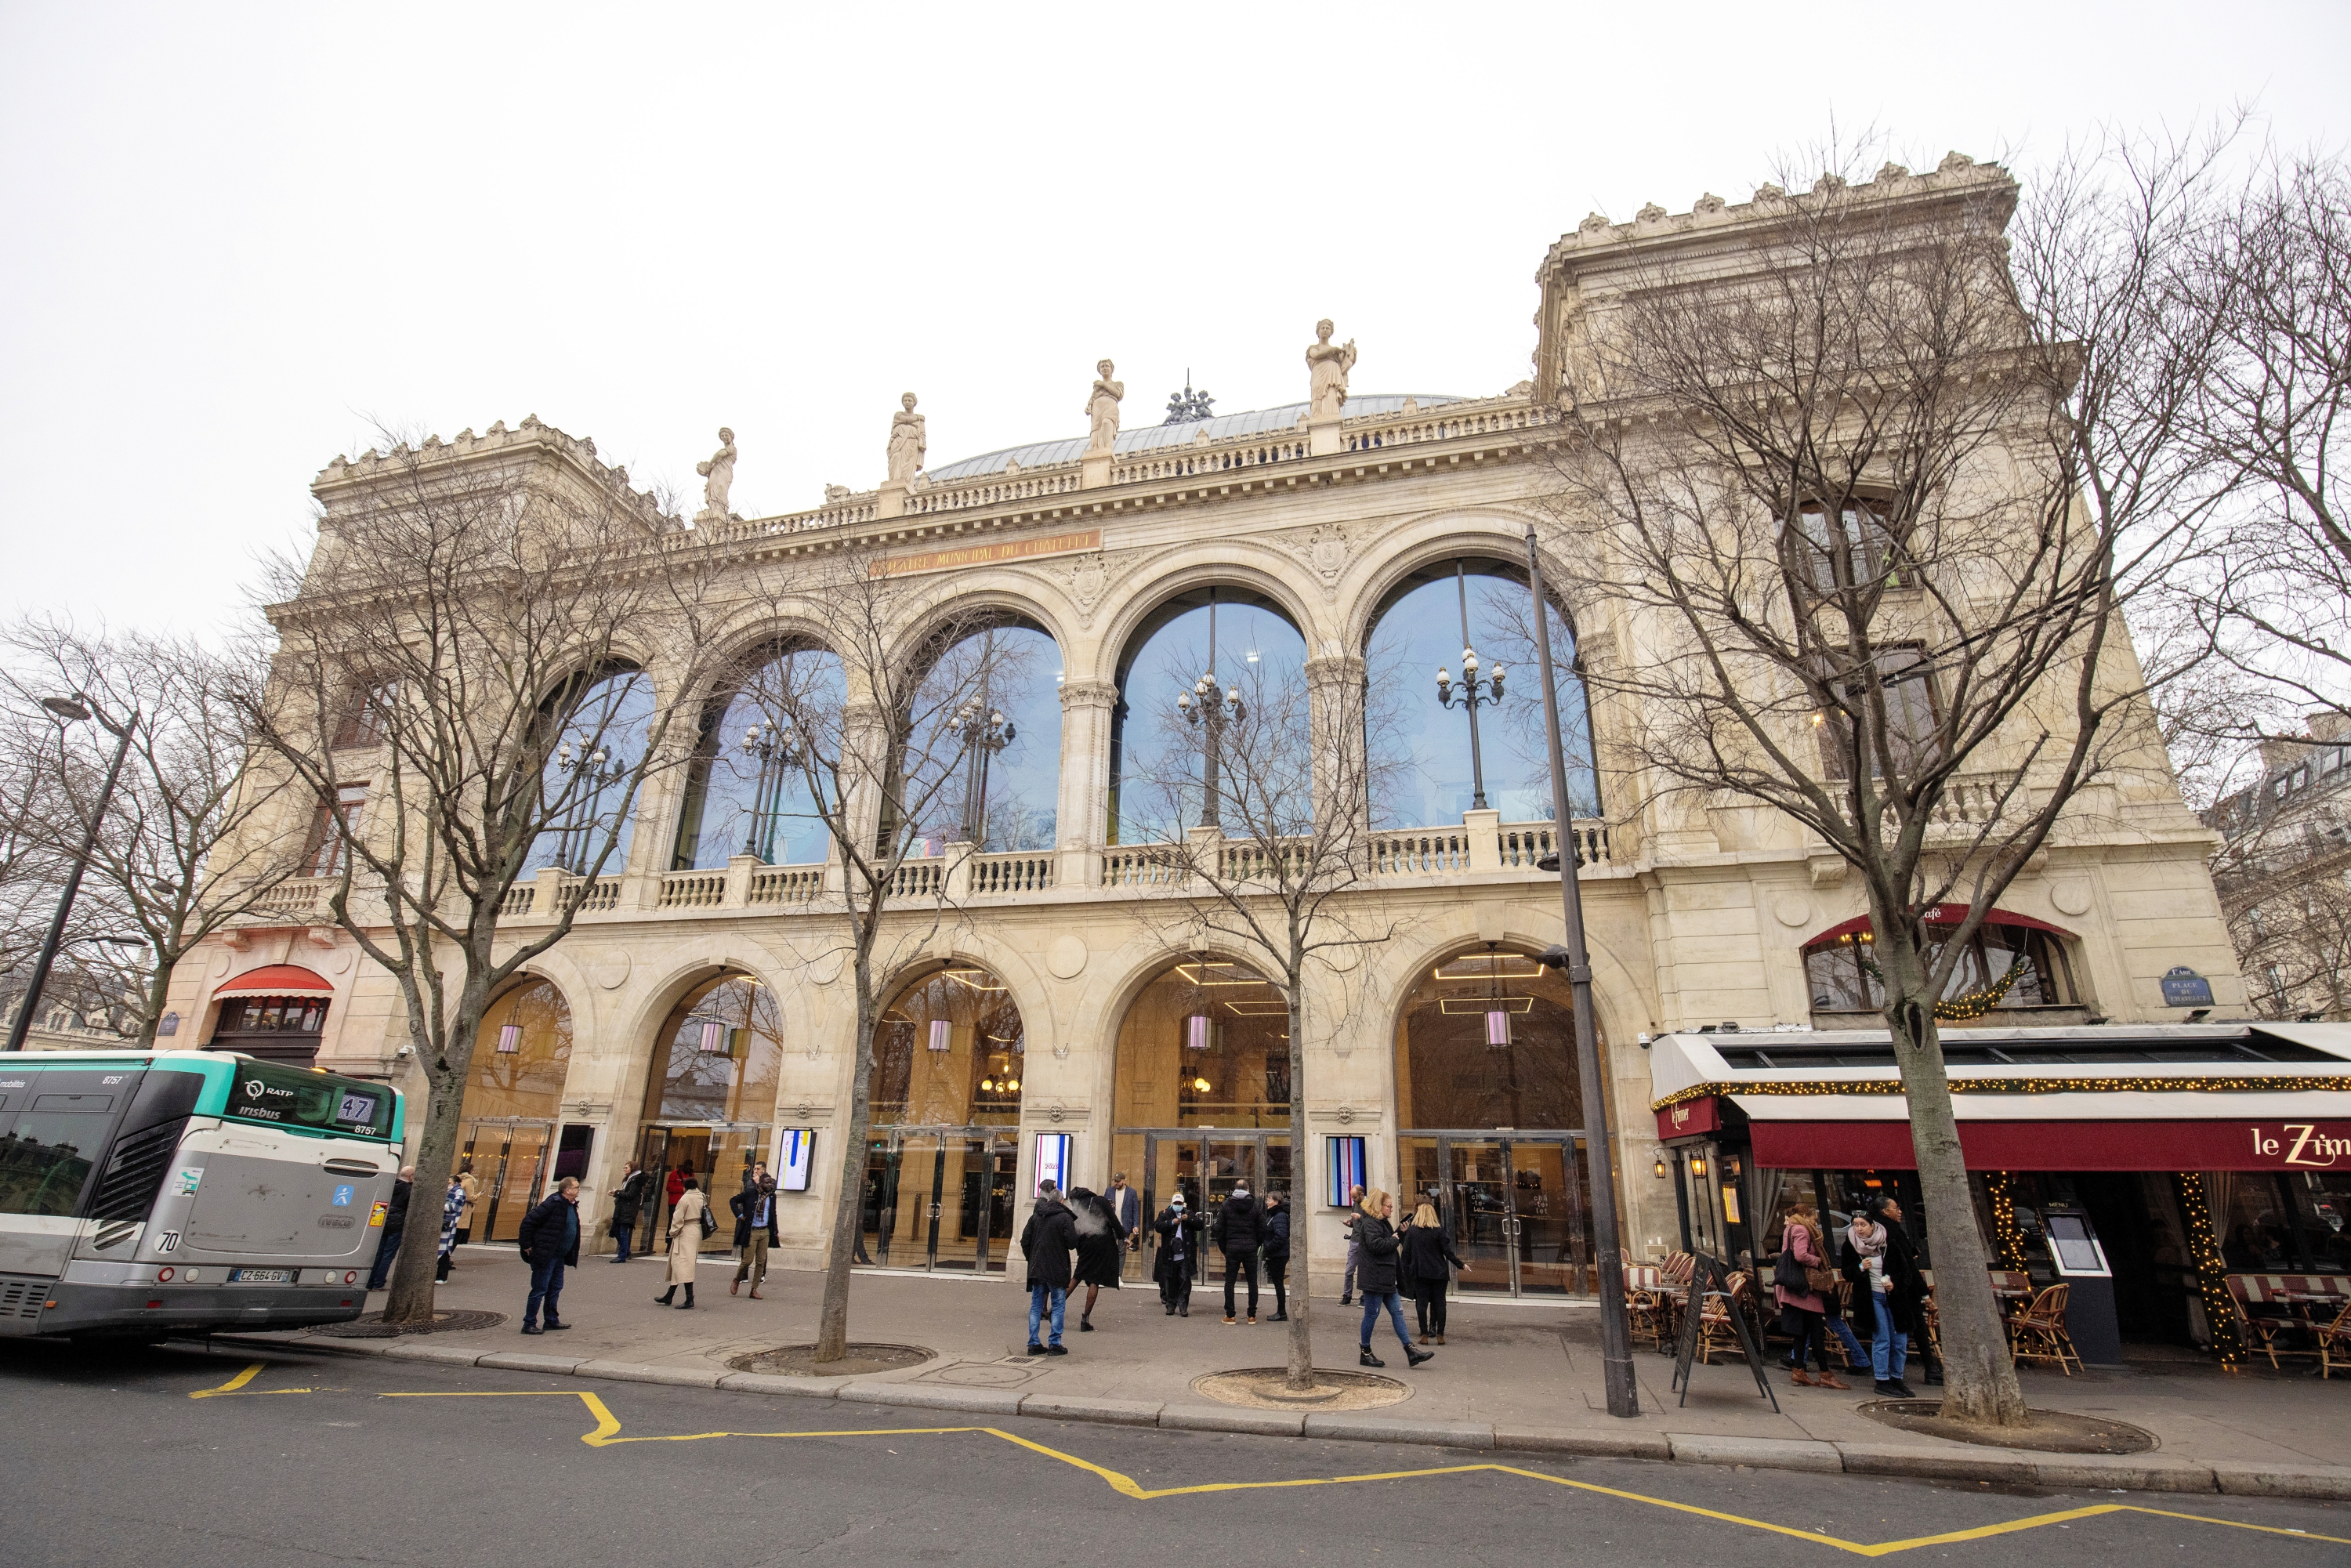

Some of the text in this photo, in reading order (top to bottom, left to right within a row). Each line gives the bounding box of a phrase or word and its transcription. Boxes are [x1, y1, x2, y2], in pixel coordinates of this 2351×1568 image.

[1002, 544, 1018, 557] DU
[1923, 907, 1941, 920] afé
[0, 1080, 26, 1088] mobilités
[102, 1075, 123, 1085] 8757
[266, 1087, 294, 1098] RATP
[342, 1098, 369, 1119] 47
[354, 1124, 376, 1135] 8757
[2251, 1128, 2280, 1156] le
[158, 1233, 179, 1251] 70
[240, 1270, 283, 1280] CZ-664-GV
